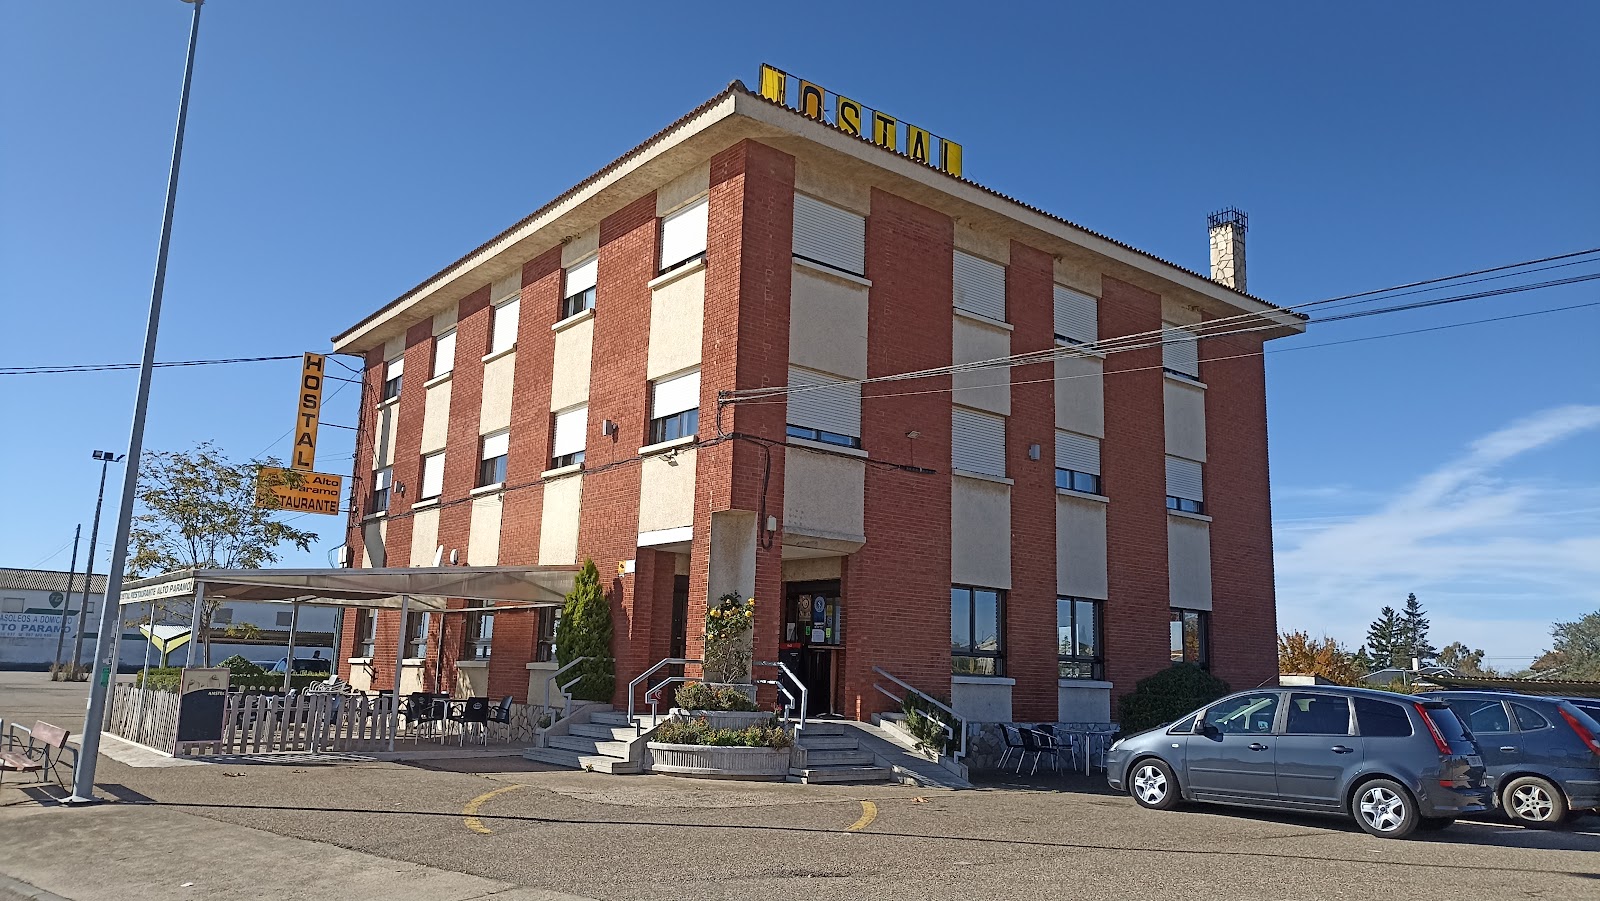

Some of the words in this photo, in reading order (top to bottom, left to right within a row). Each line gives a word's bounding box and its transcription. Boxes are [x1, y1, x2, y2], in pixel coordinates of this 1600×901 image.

[761, 66, 950, 172] OSTAL
[296, 355, 322, 467] HOSTAL
[312, 476, 339, 487] Alto
[156, 585, 169, 594] ALTO
[0, 614, 31, 623] ASOLEOS
[0, 623, 17, 631] TO
[21, 624, 71, 634] PARAMO
